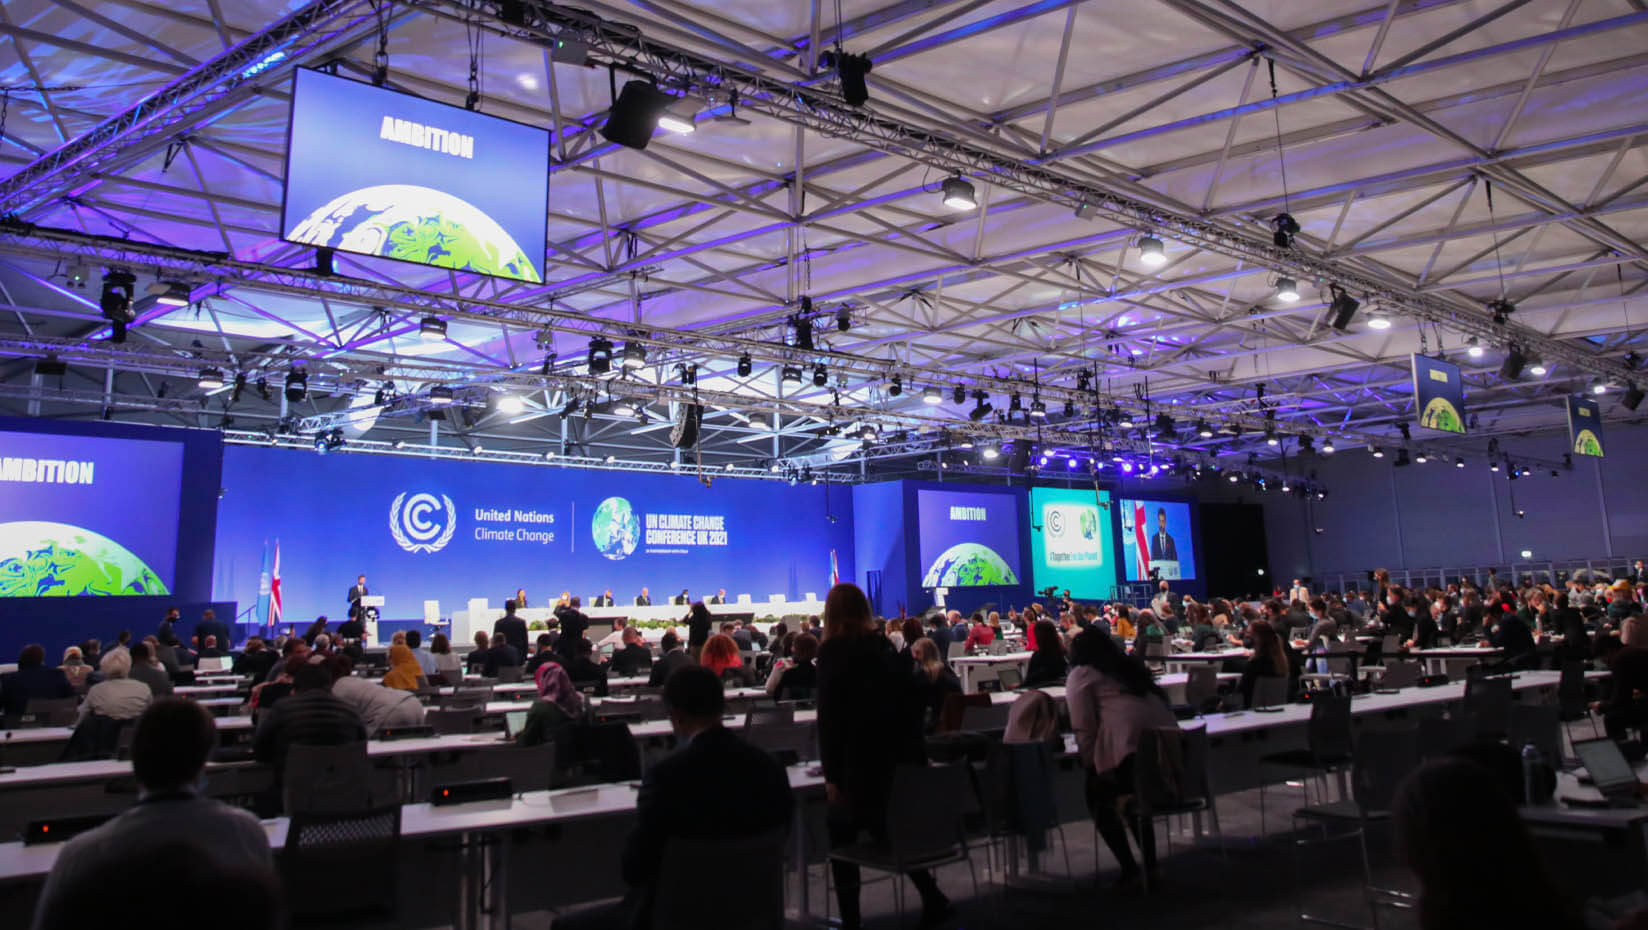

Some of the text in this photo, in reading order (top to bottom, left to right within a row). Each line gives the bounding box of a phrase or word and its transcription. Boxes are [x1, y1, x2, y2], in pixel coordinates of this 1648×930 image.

[380, 115, 474, 159] AMBITION
[474, 508, 554, 523] United Nations
[950, 506, 986, 520] AMBITION
[645, 513, 725, 530] UN CLIMATE CHANGE
[474, 527, 554, 544] Climate Change
[645, 529, 728, 545] CONFERENCE UK 2021
